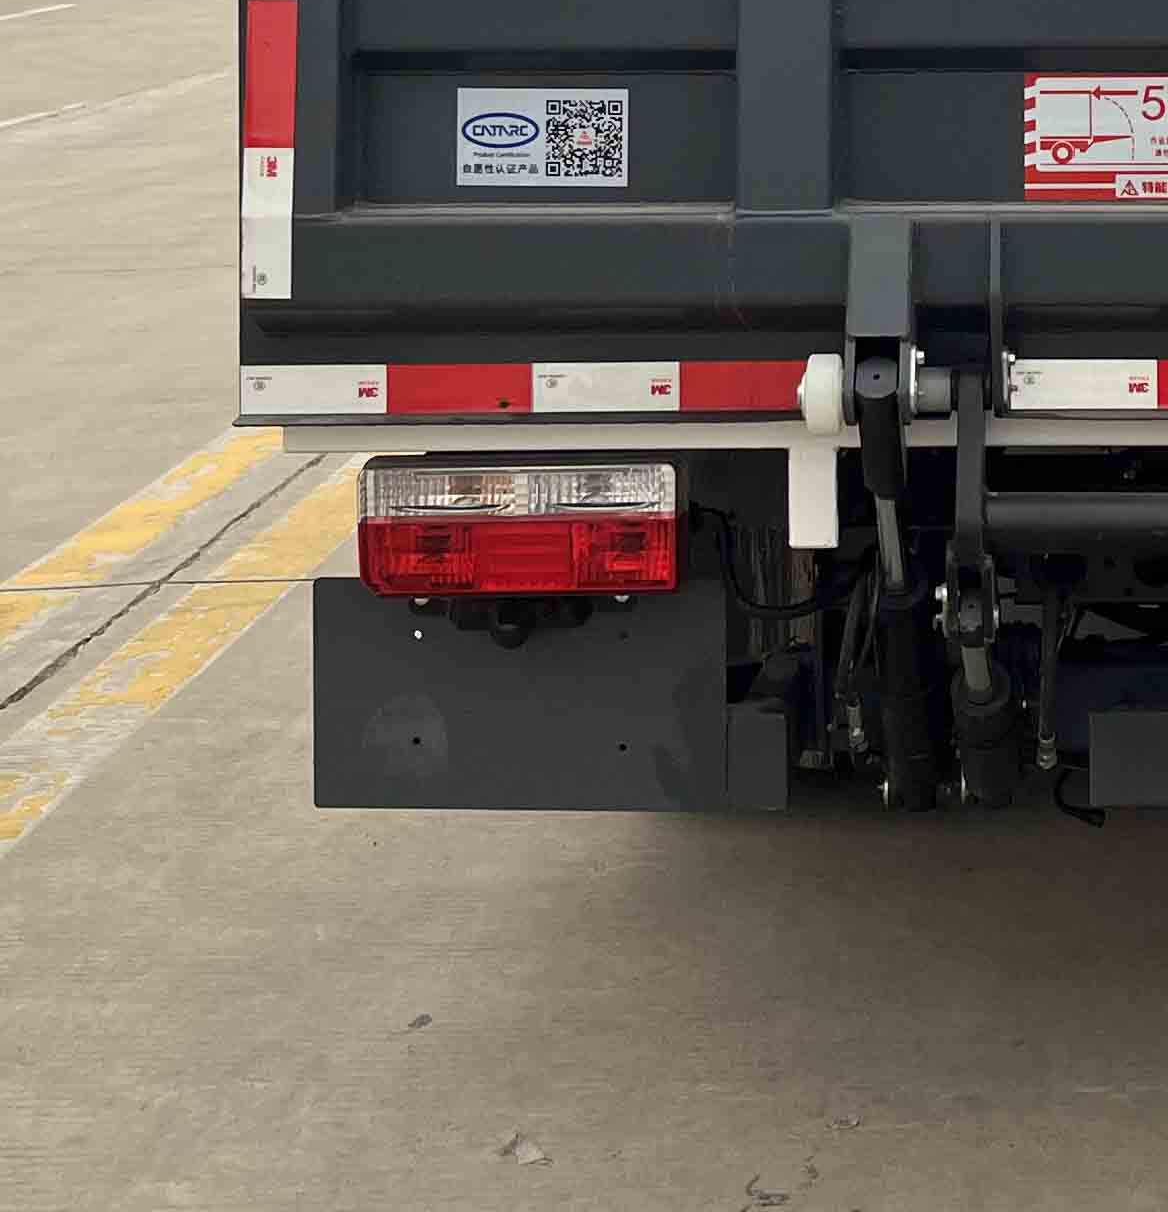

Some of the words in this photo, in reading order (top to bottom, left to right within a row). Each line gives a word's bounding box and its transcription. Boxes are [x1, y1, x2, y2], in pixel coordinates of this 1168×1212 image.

[266, 156, 277, 177] 3M
[358, 386, 379, 397] 3M
[651, 384, 672, 395] 3M
[1128, 382, 1149, 393] 3M
